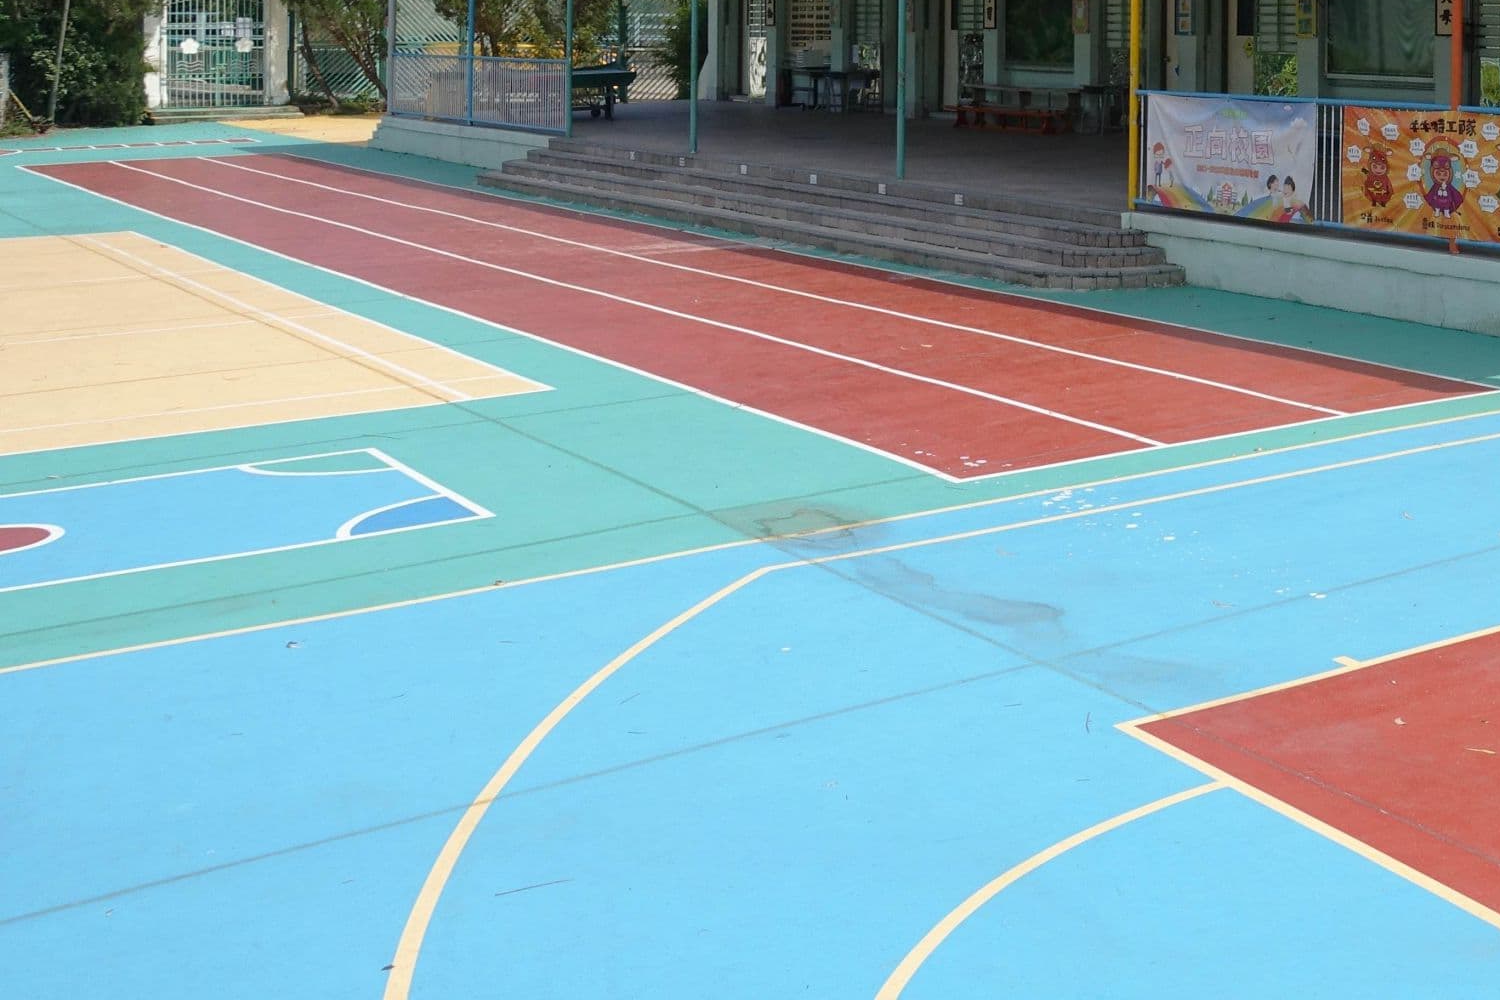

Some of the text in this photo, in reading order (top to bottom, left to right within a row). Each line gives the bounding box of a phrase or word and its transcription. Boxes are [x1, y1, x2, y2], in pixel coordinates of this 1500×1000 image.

[1409, 118, 1477, 137] 牛牛特工隊
[1183, 124, 1274, 166] 正向校園
